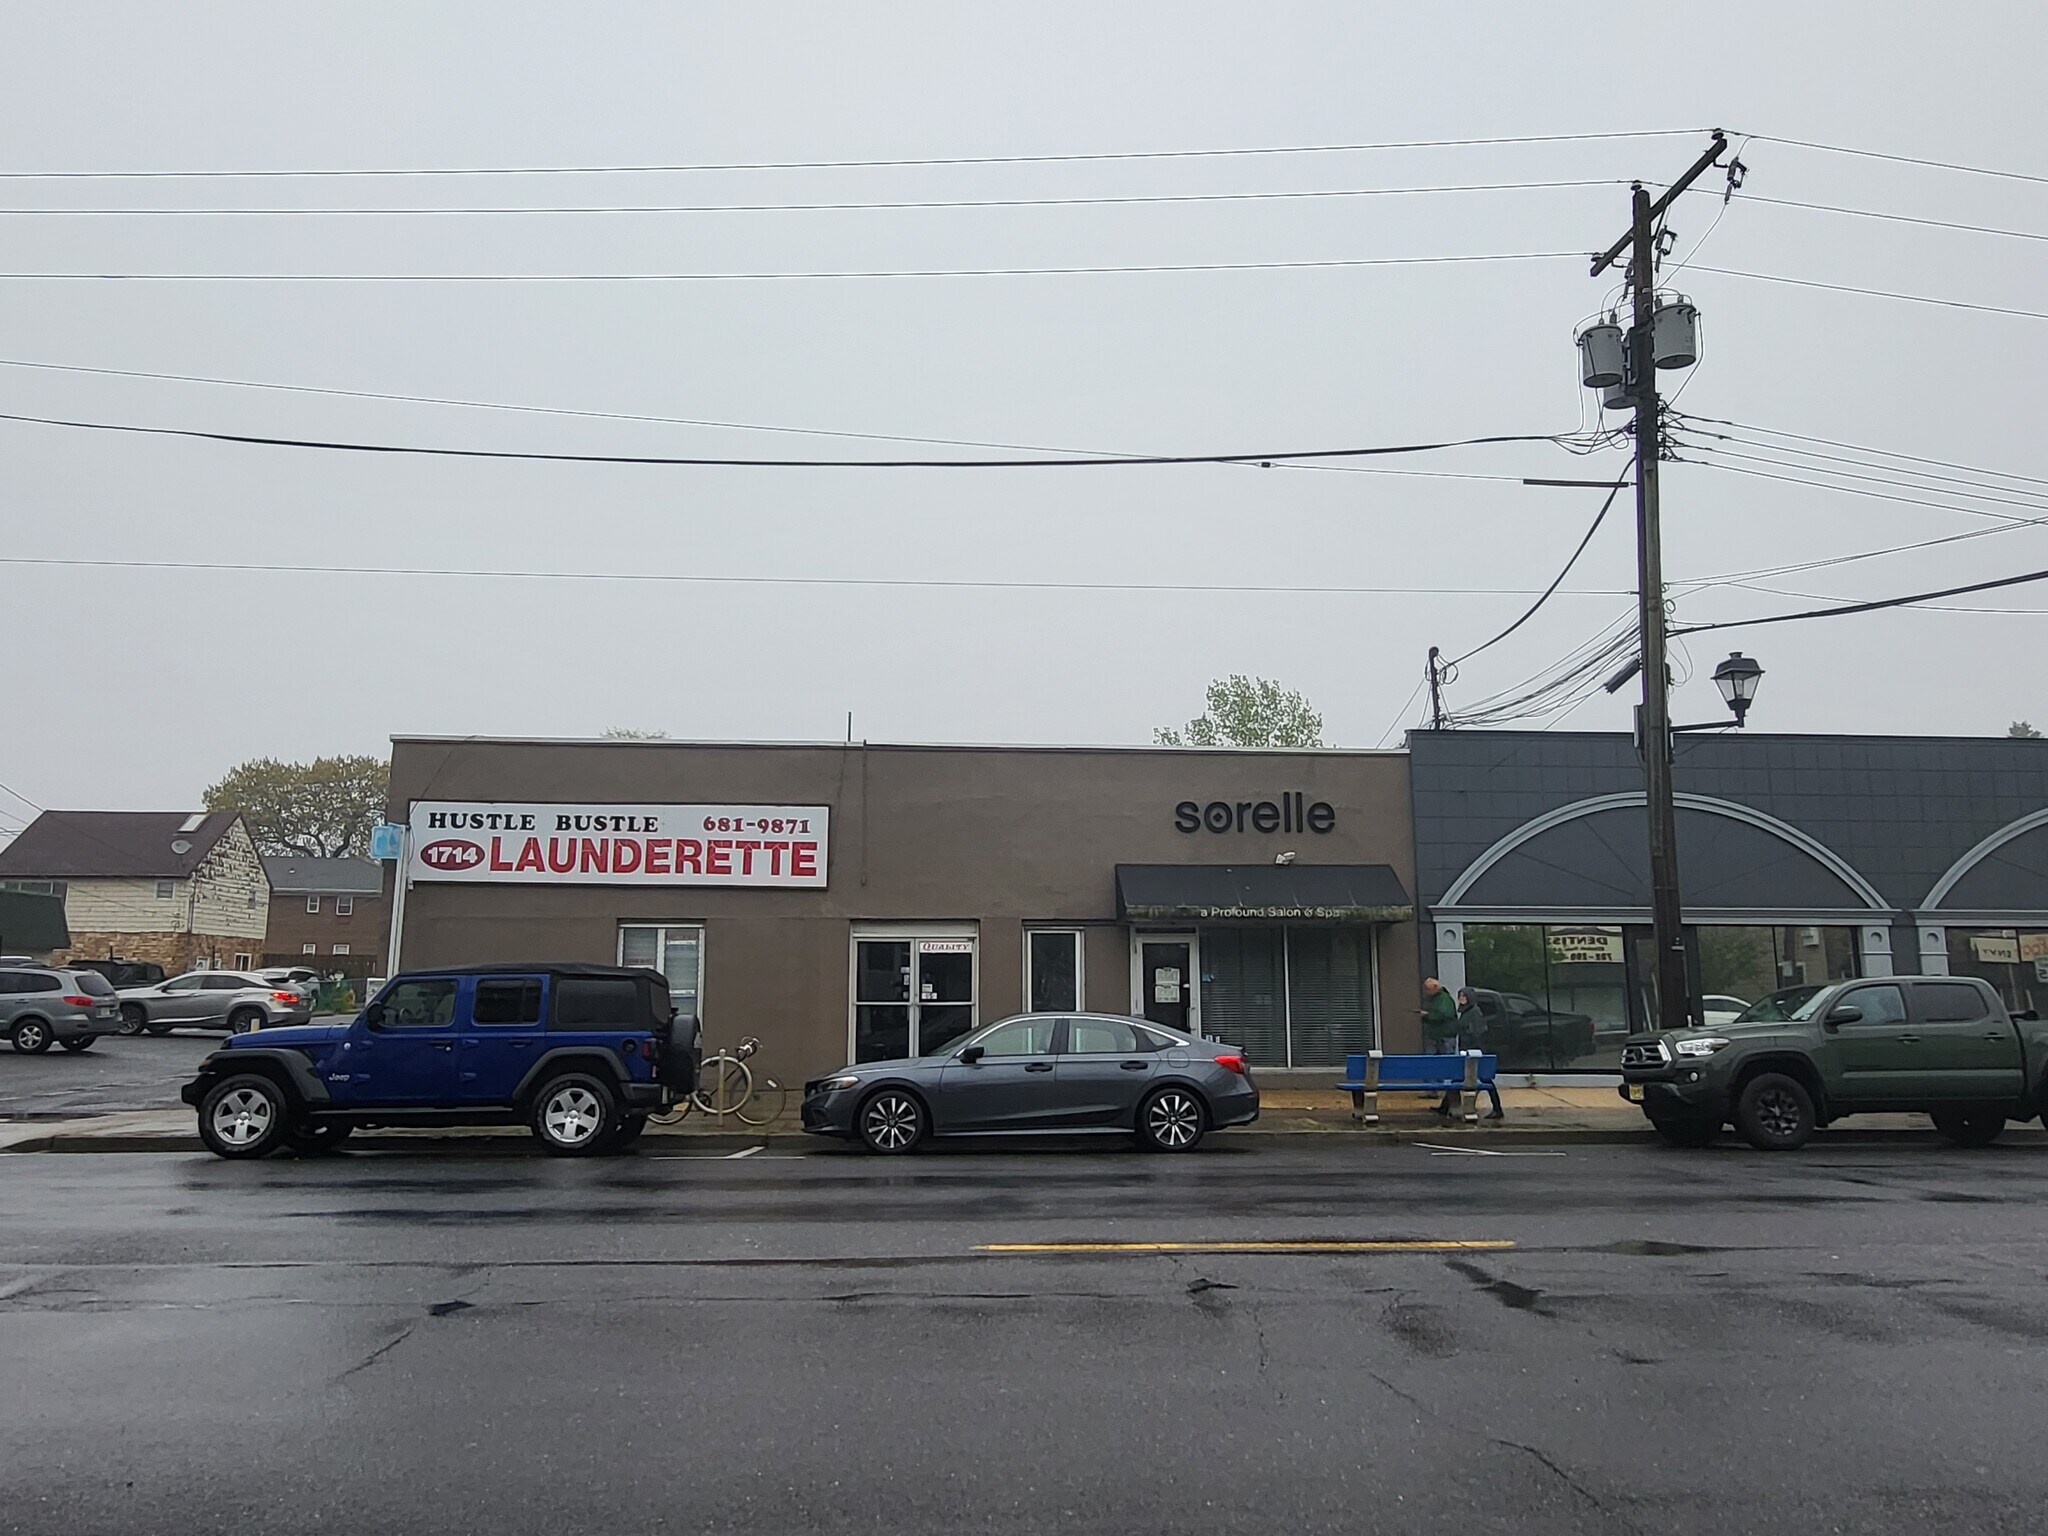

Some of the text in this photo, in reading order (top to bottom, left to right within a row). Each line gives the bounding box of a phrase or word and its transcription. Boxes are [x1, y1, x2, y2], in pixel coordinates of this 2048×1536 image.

[1174, 792, 1336, 834] sorelle
[428, 812, 659, 833] HUSTLE BUSTLE
[703, 816, 811, 834] 681-9871
[427, 846, 478, 864] 1714
[489, 837, 818, 876] LAUNDERETTE
[1211, 906, 1264, 917] Profound
[1268, 907, 1301, 917] Salon
[1316, 907, 1340, 919] Spa
[329, 1073, 350, 1081] Jeep
